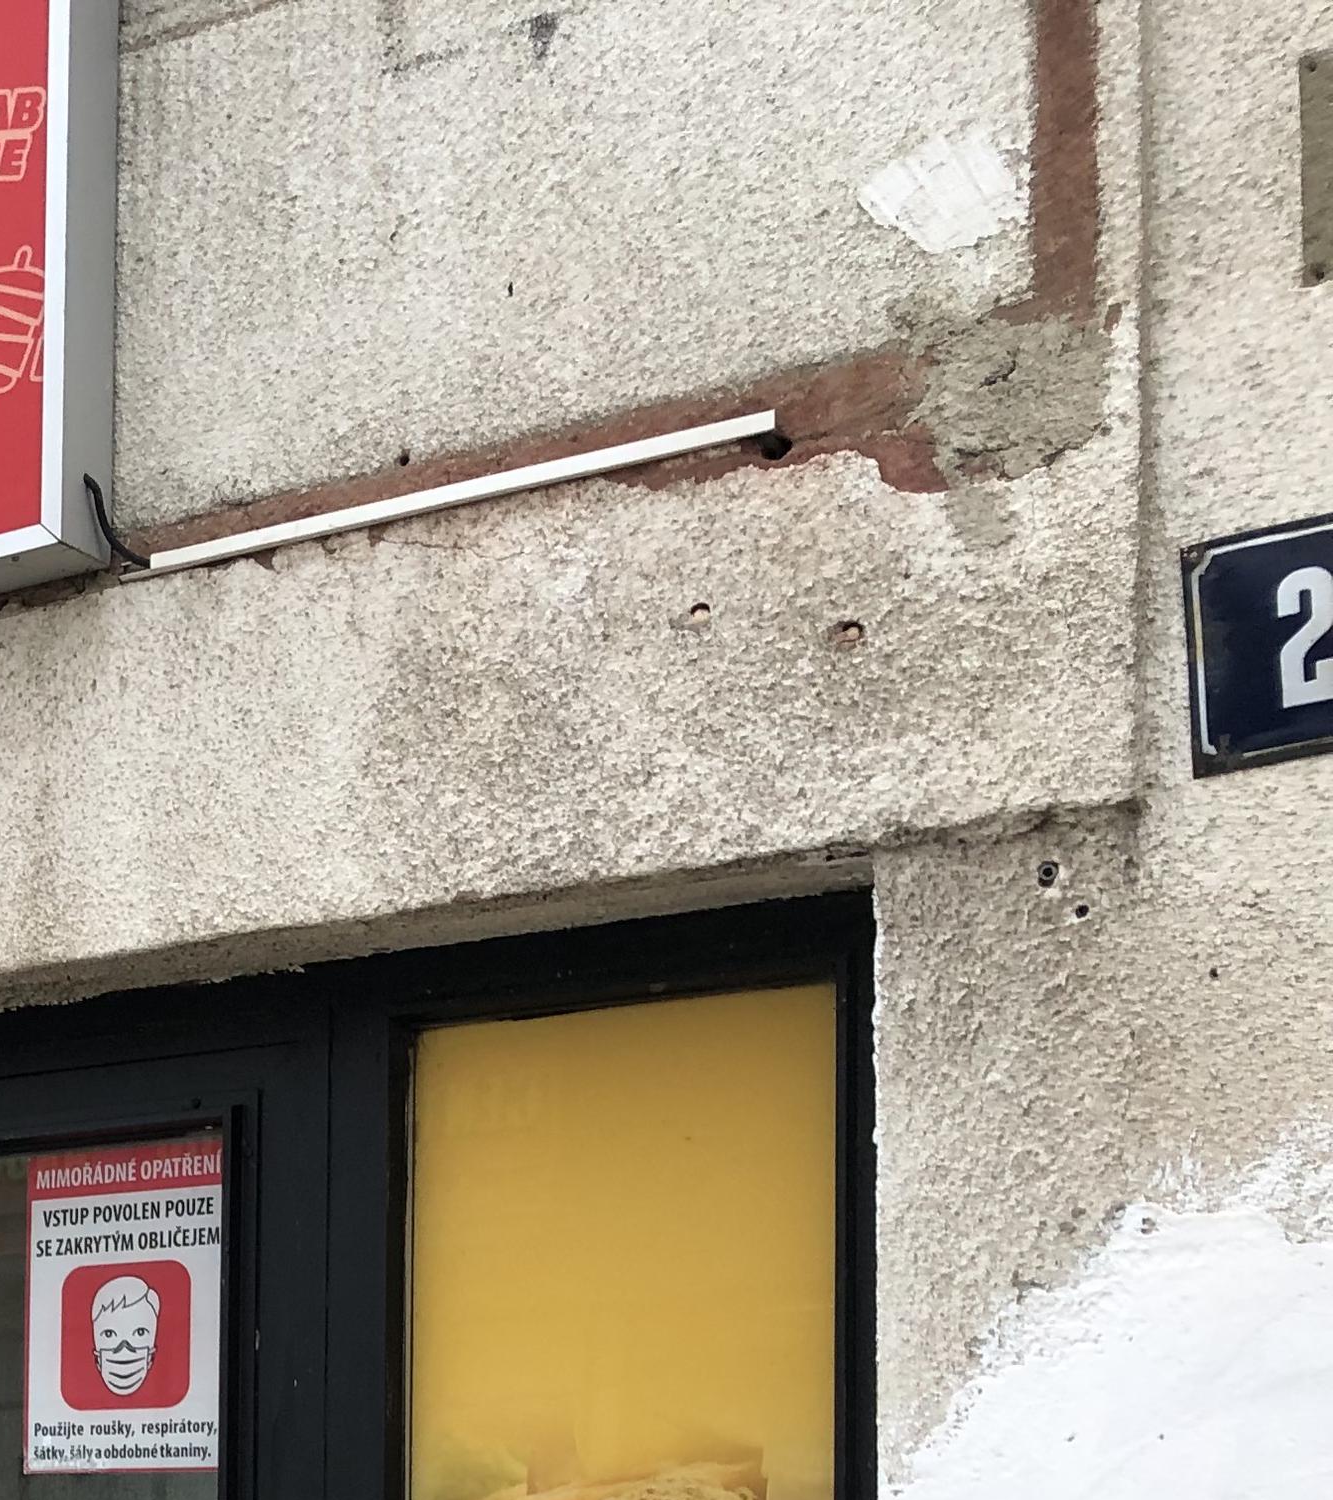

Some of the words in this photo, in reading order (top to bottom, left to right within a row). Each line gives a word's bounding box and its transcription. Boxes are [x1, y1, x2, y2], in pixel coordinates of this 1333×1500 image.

[36, 1157, 136, 1190] MIMOŘÁDNÉ
[141, 1148, 222, 1180] OPATŘENÍ
[43, 1207, 89, 1228] VSTUP
[93, 1202, 160, 1224] POVOLEN
[165, 1197, 214, 1217] POUZE
[36, 1239, 52, 1257] SE
[56, 1230, 133, 1256] ZAKRYTÝM
[138, 1226, 220, 1250] OBLIČEJEM
[34, 1422, 84, 1439] Použijte
[90, 1420, 135, 1438] roušky,
[141, 1419, 217, 1437] respirátory,
[95, 1449, 101, 1459] a
[104, 1444, 158, 1459] obdobné
[160, 1443, 211, 1460] tkaniny.
